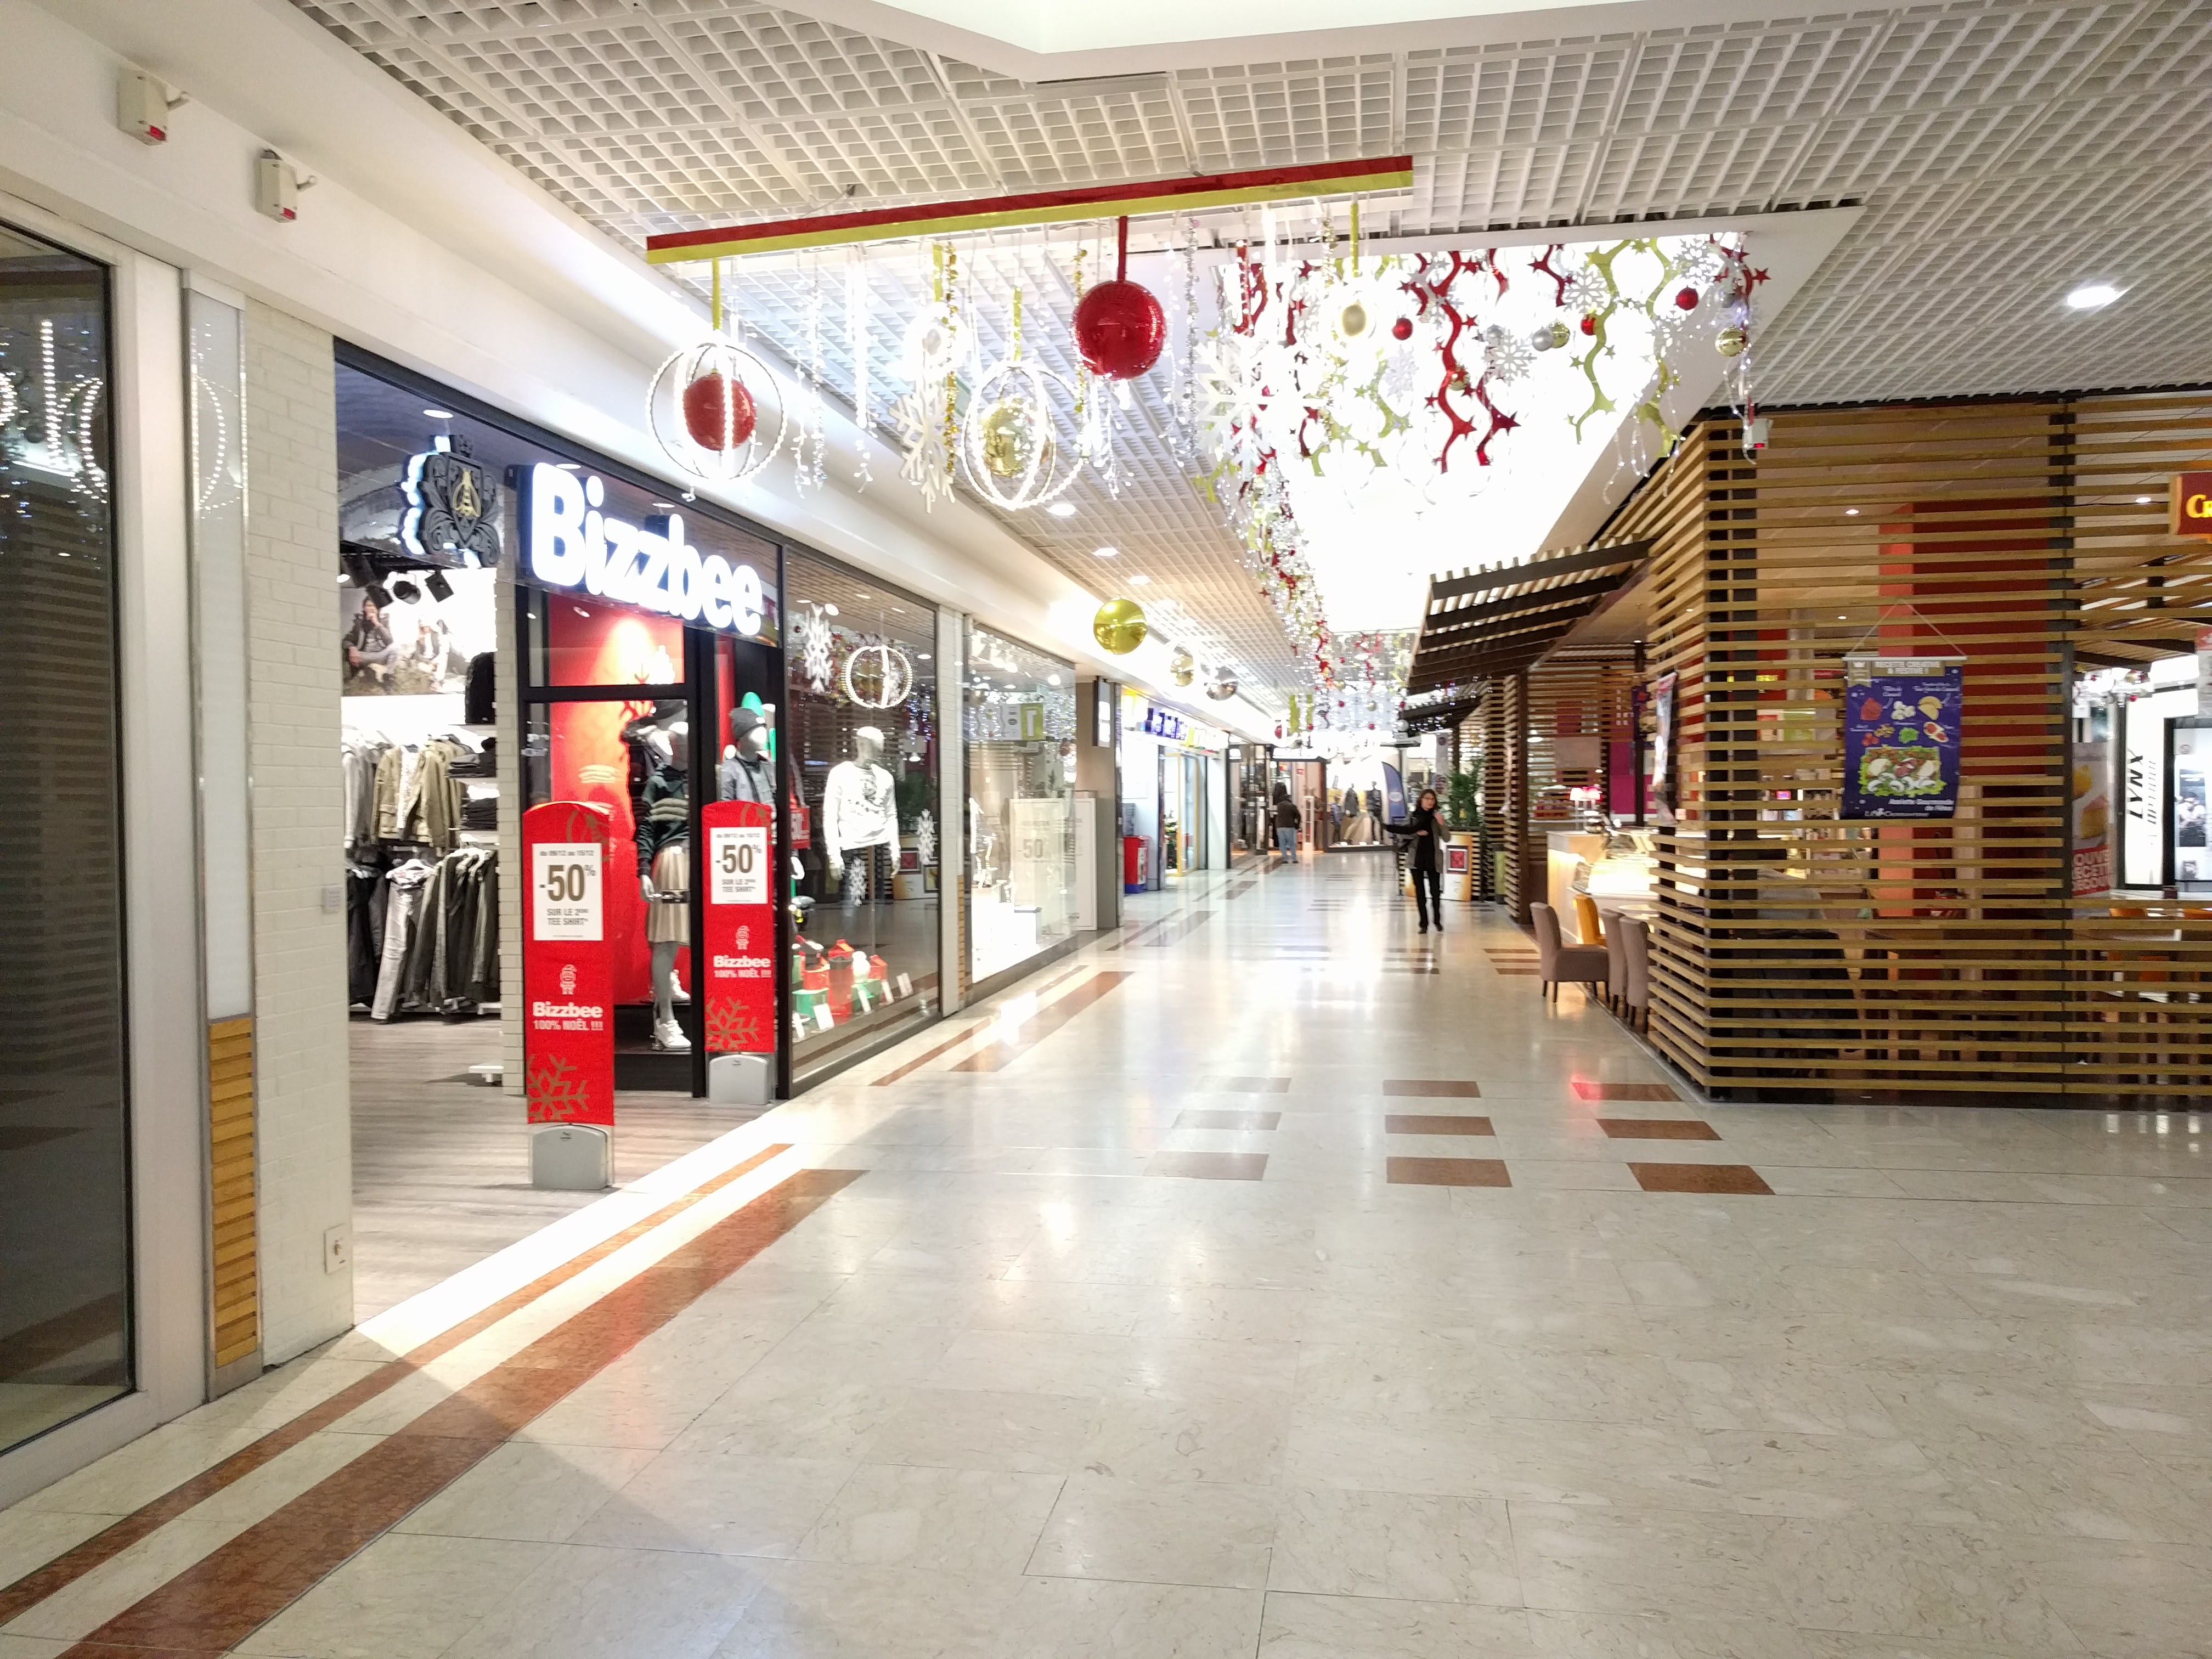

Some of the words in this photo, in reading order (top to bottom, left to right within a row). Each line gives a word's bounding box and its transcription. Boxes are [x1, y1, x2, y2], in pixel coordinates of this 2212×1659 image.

[532, 462, 763, 635] Bizzbee
[2127, 748, 2143, 820] LYNX
[715, 844, 763, 874] -50%
[539, 864, 597, 902] -50%
[714, 955, 771, 968] Bizzbee
[714, 969, 737, 978] 100%
[533, 1001, 603, 1018] Bizzbee
[533, 1019, 561, 1030] 100%
[562, 1018, 590, 1031] NOËL
